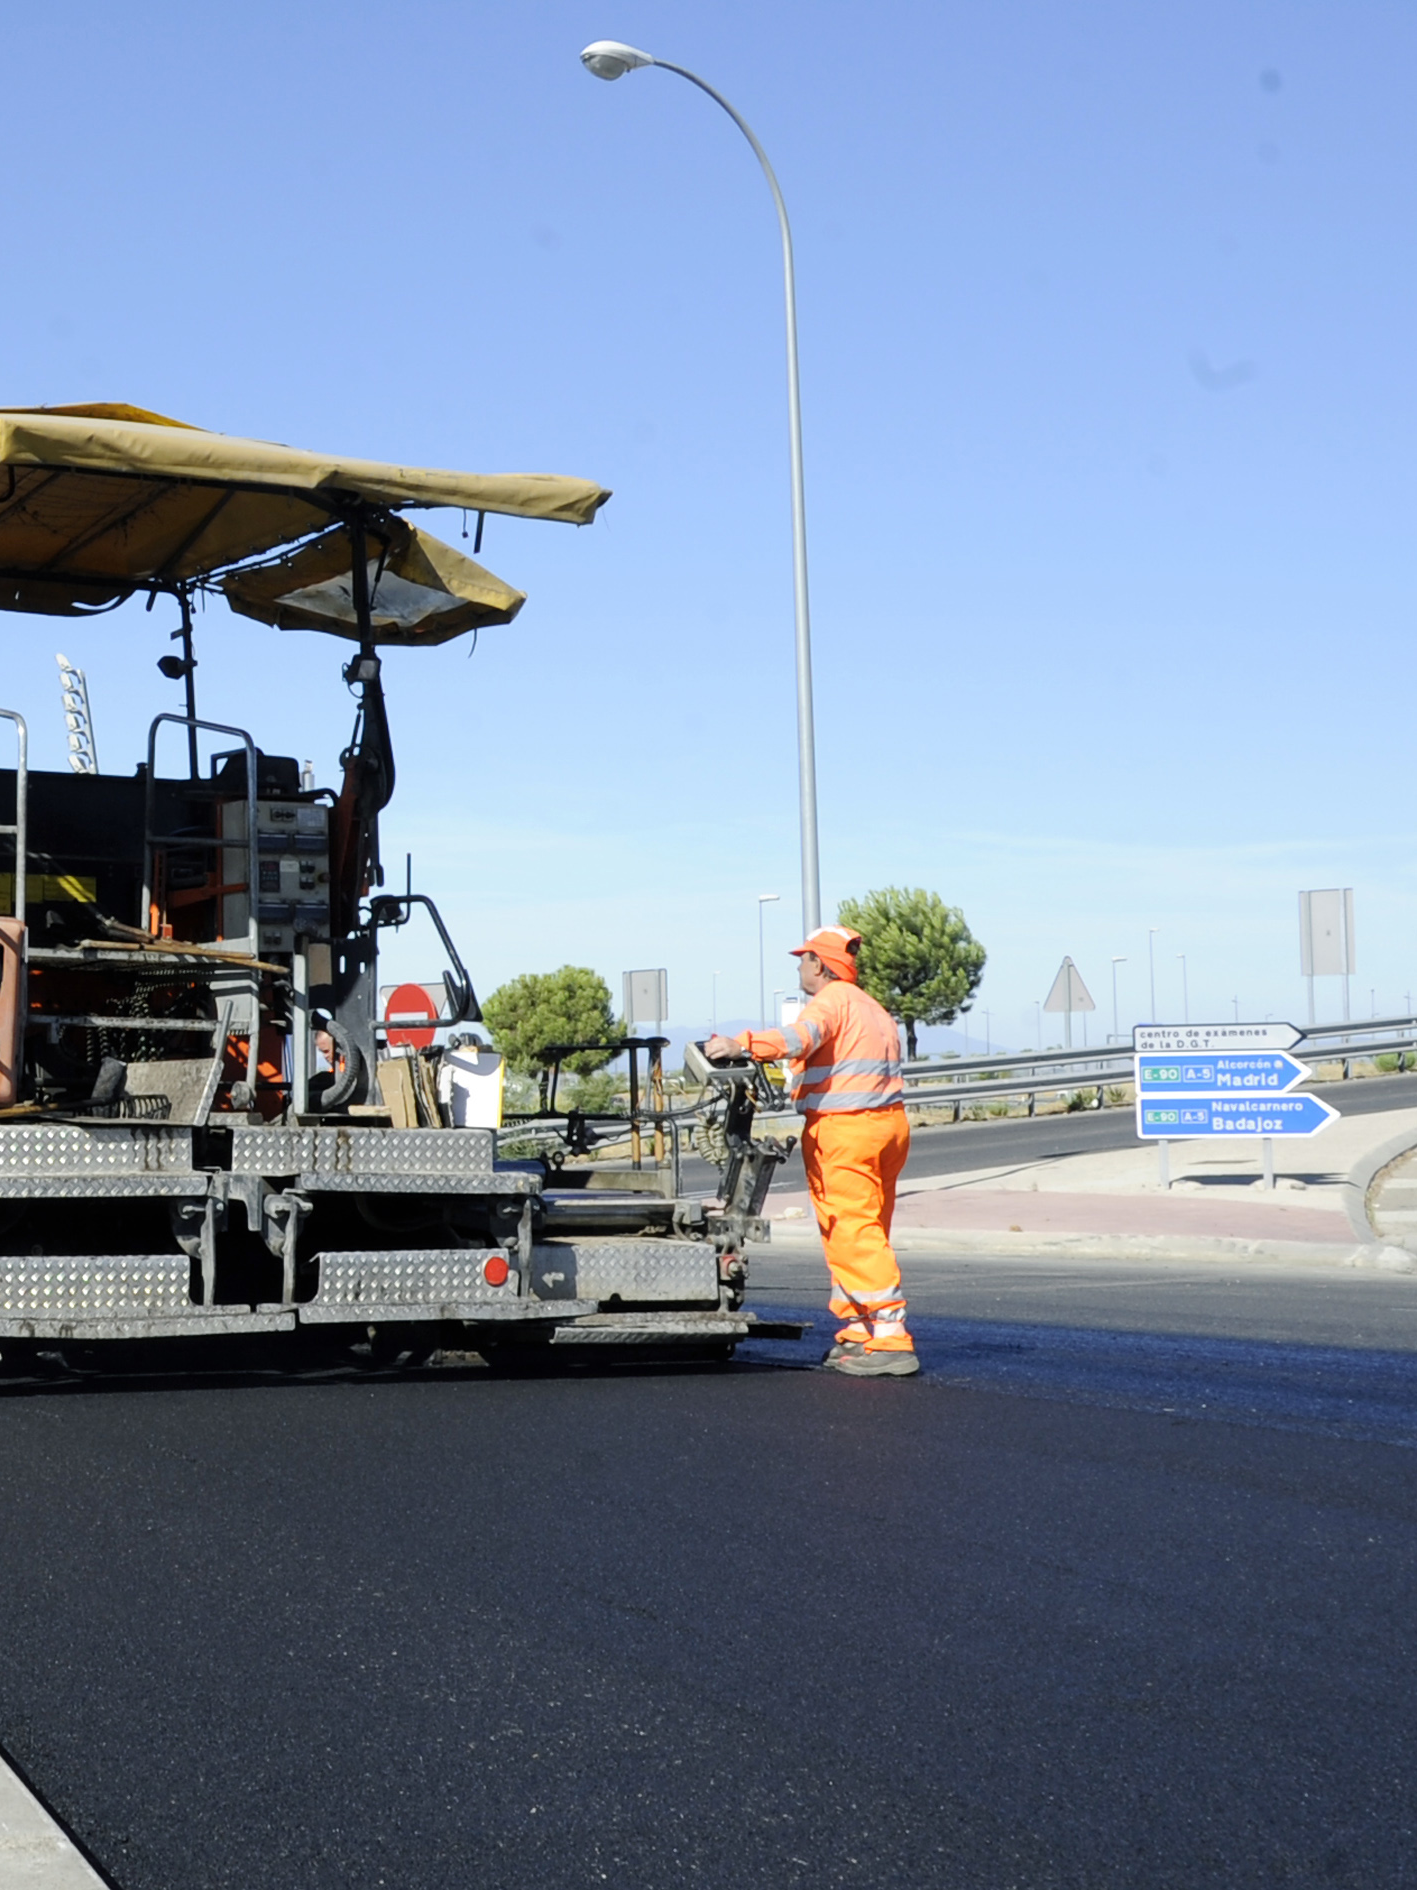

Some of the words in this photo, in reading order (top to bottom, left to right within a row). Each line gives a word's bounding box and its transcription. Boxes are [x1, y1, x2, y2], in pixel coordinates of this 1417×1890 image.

[1140, 1029, 1180, 1039] centro
[1186, 1029, 1200, 1038] de
[1141, 1040, 1155, 1050] de
[1159, 1040, 1171, 1049] la
[1176, 1039, 1215, 1049] D.G.T.
[1217, 1058, 1272, 1070] Alcorcón
[1144, 1069, 1178, 1080] E-90
[1186, 1068, 1212, 1079] A-5
[1216, 1073, 1279, 1087] Madrid
[1211, 1101, 1304, 1113] Navalcarnero
[1146, 1112, 1176, 1122] E-90
[1183, 1112, 1205, 1122] A-5
[1212, 1116, 1284, 1133] Badajoz
